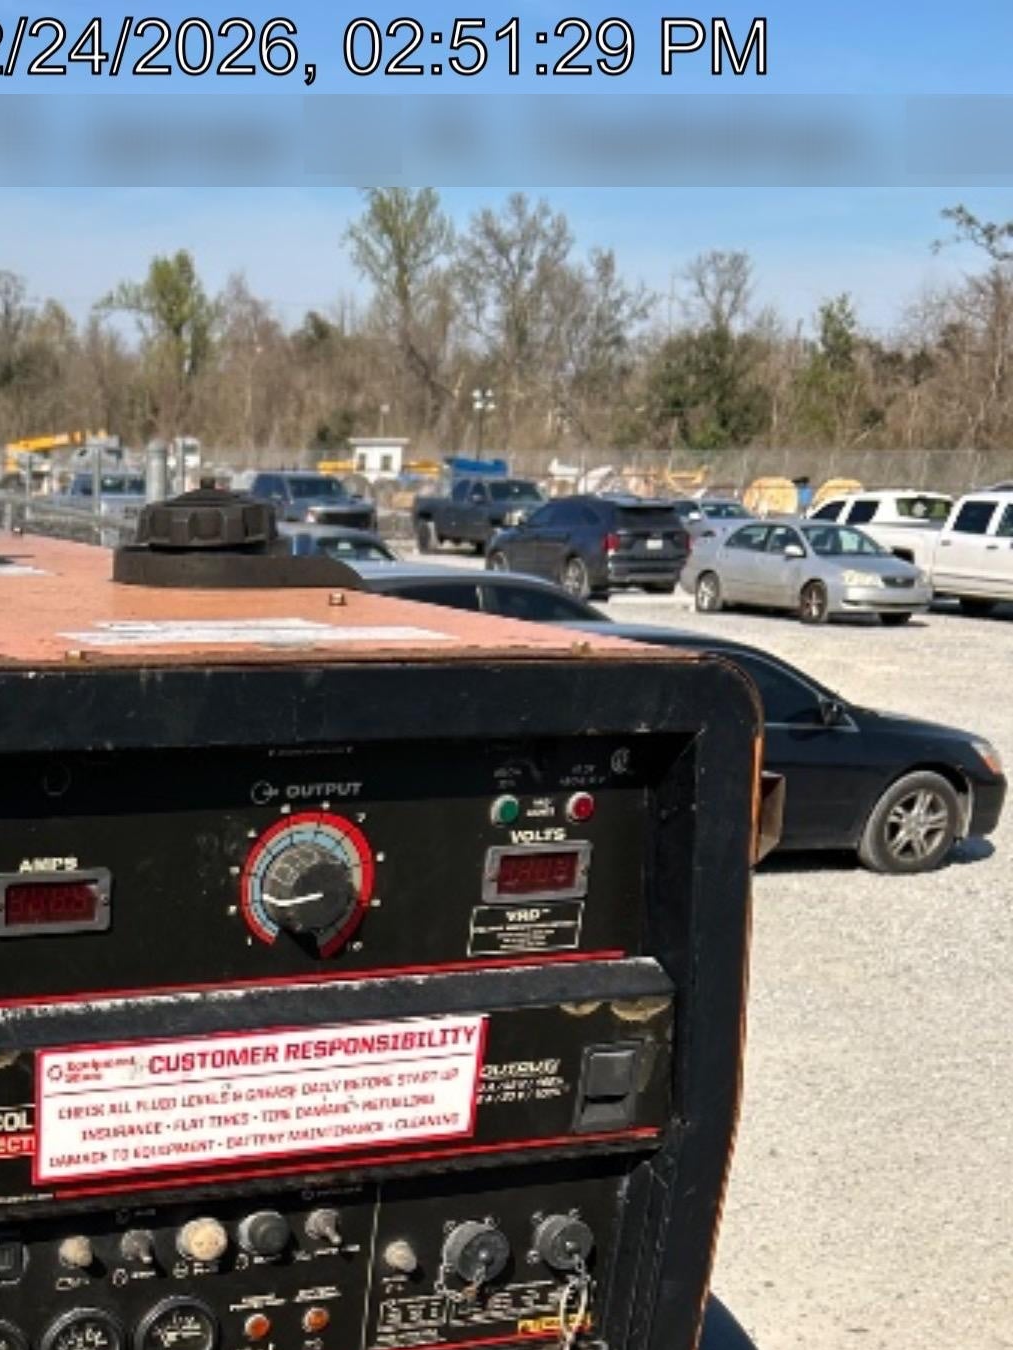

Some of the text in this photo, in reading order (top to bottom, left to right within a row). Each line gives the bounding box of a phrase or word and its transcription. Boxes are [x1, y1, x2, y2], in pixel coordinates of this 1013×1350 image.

[286, 782, 363, 799] OUTPUT
[510, 827, 567, 844] VOLTS
[19, 856, 79, 874] AMPS
[148, 1045, 278, 1075] CUSTOMER
[284, 1026, 477, 1063] RESPONSIBILITY
[58, 1102, 105, 1120] CHECK
[109, 1100, 132, 1114] ALL
[301, 1080, 341, 1096] DAILY
[81, 1122, 162, 1141] INSURANCE
[173, 1117, 206, 1131] FLAT
[133, 1139, 214, 1159] EQUIPMENT
[394, 1112, 460, 1131] CLEANING
